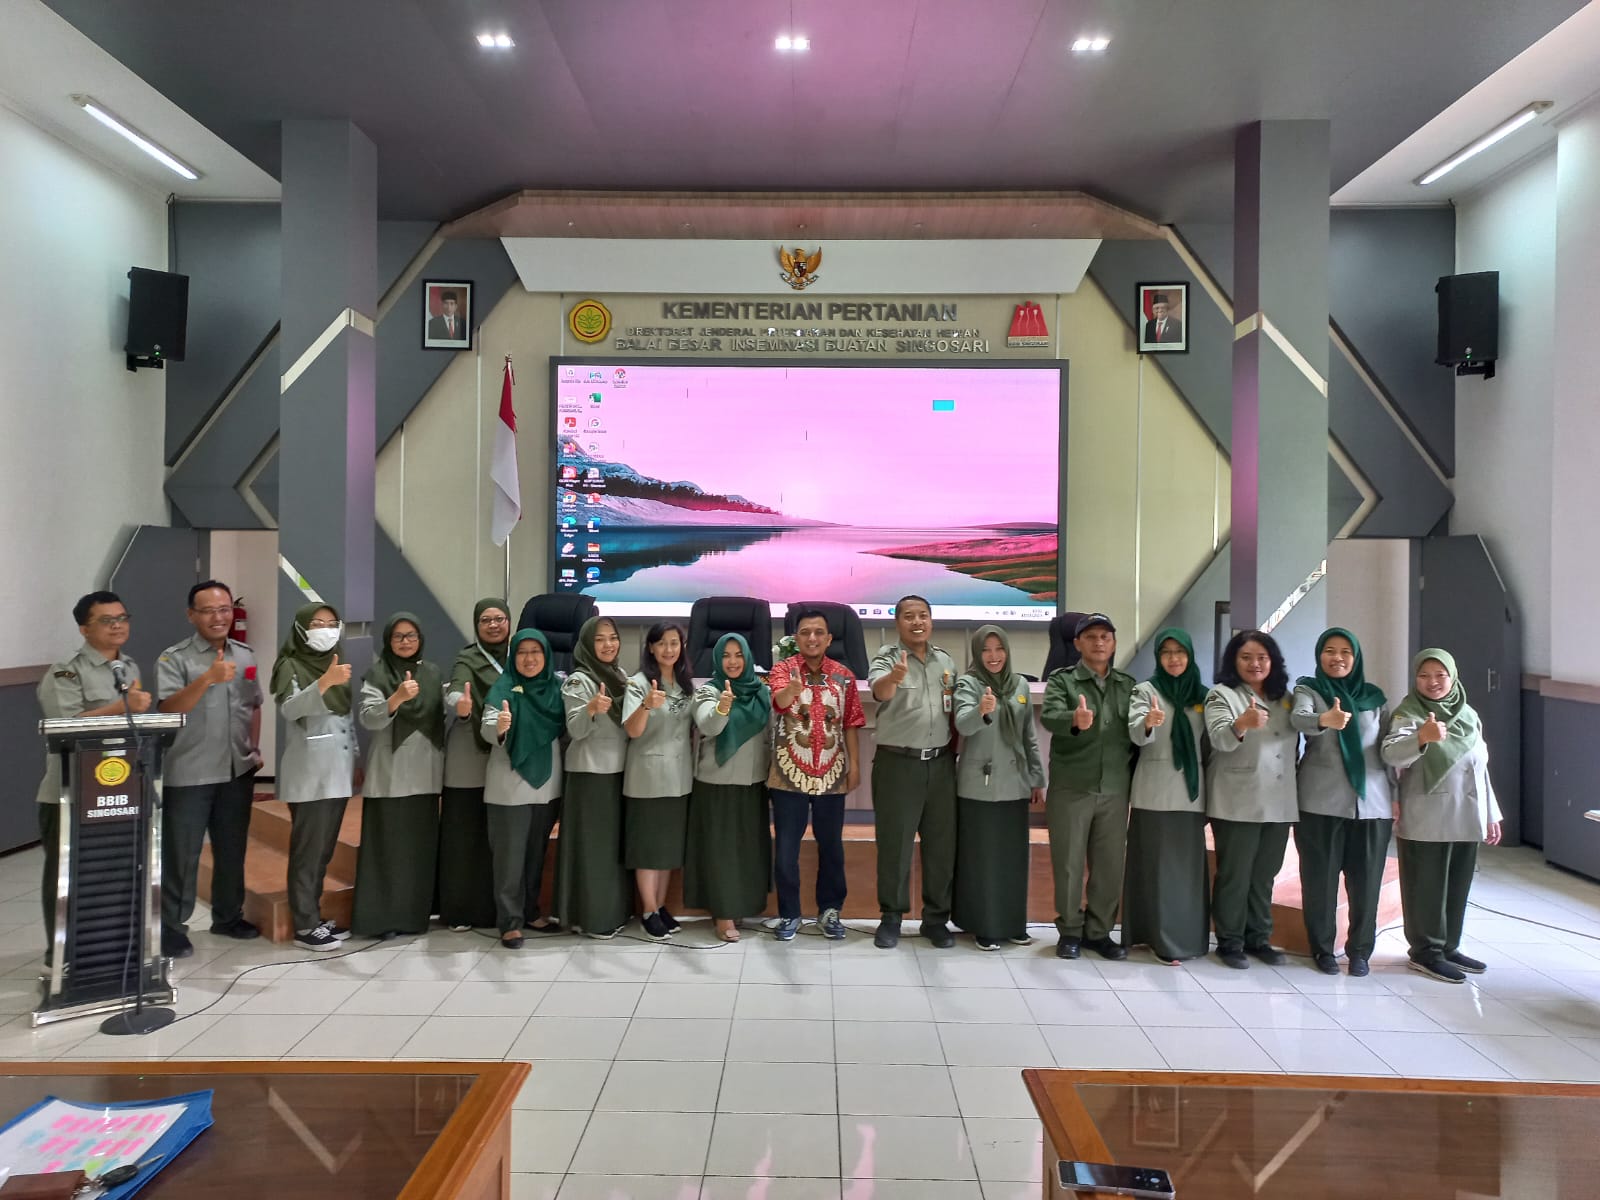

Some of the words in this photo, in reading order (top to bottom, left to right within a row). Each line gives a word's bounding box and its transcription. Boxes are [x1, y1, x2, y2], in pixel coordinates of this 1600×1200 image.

[663, 302, 822, 320] KEMENTERIAN
[828, 303, 958, 321] PERTANIAN
[839, 328, 863, 338] DAN
[615, 338, 662, 351] BALAI
[668, 338, 722, 351] BESAR
[731, 338, 819, 352] INSEMINASI
[895, 339, 989, 353] SINGOSARI
[96, 794, 129, 807] BBIB
[86, 806, 139, 818] SINGOSARI
